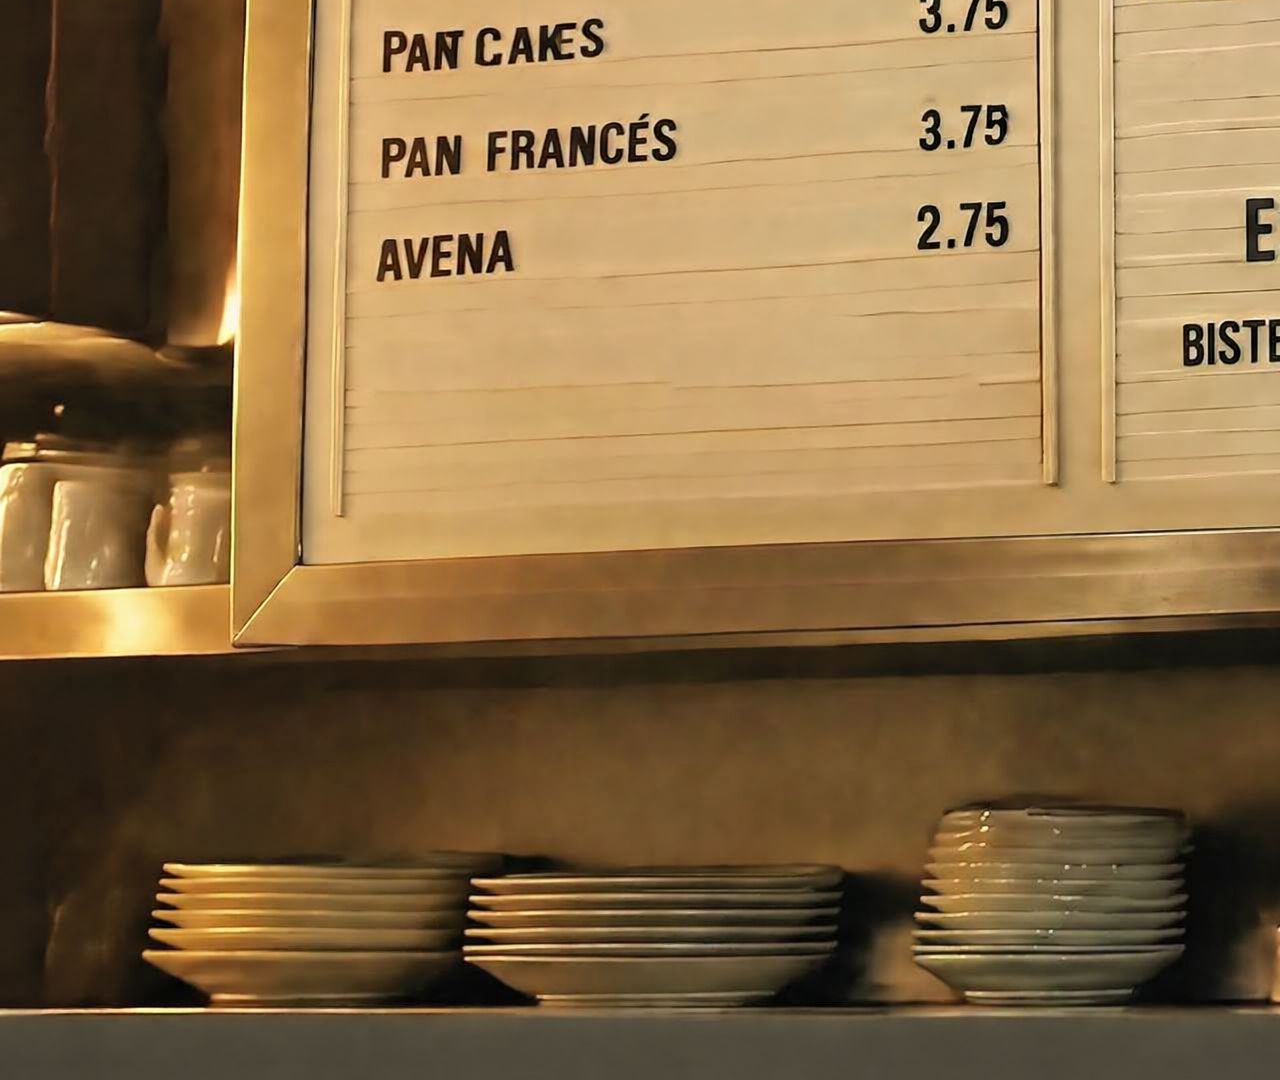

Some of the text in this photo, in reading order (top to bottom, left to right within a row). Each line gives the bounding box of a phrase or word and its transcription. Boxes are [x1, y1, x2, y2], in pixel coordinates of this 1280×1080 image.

[381, 104, 1009, 179] PAN FRANCÉS 3.75
[376, 201, 1010, 282] AVENA 2.75
